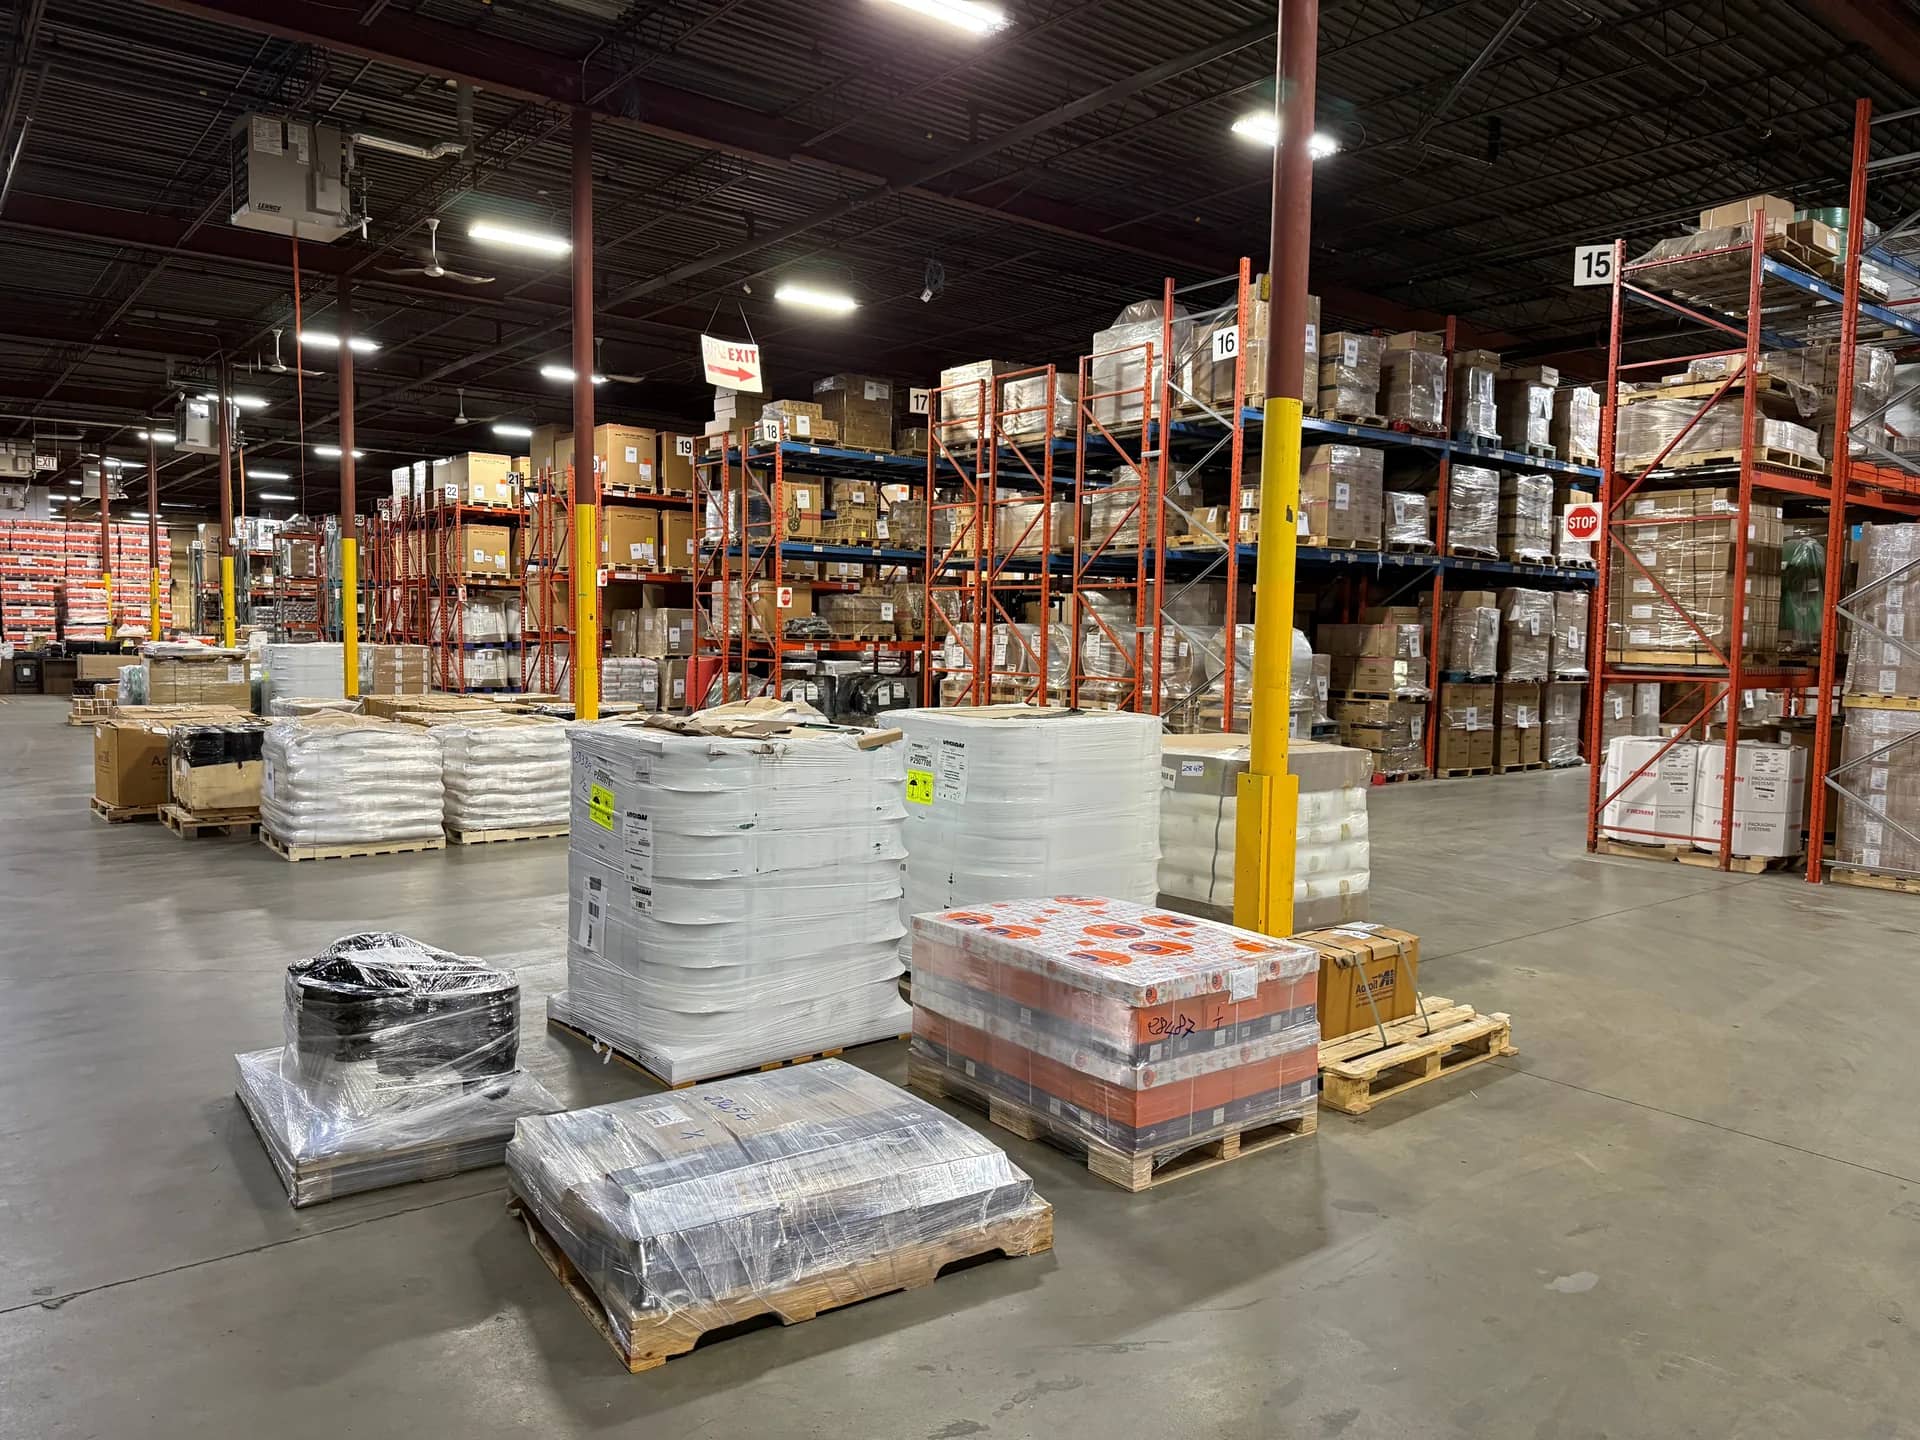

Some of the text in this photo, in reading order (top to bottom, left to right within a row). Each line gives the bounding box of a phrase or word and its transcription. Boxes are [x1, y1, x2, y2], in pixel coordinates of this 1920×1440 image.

[1582, 251, 1611, 278] 15
[1218, 332, 1235, 355] 16
[727, 347, 757, 364] EXIT
[913, 393, 928, 411] 17
[766, 423, 778, 440] 18
[679, 440, 693, 454] 19
[508, 473, 519, 485] 21
[446, 486, 457, 497] 22
[378, 500, 389, 508] 23
[1568, 516, 1597, 529] STOP
